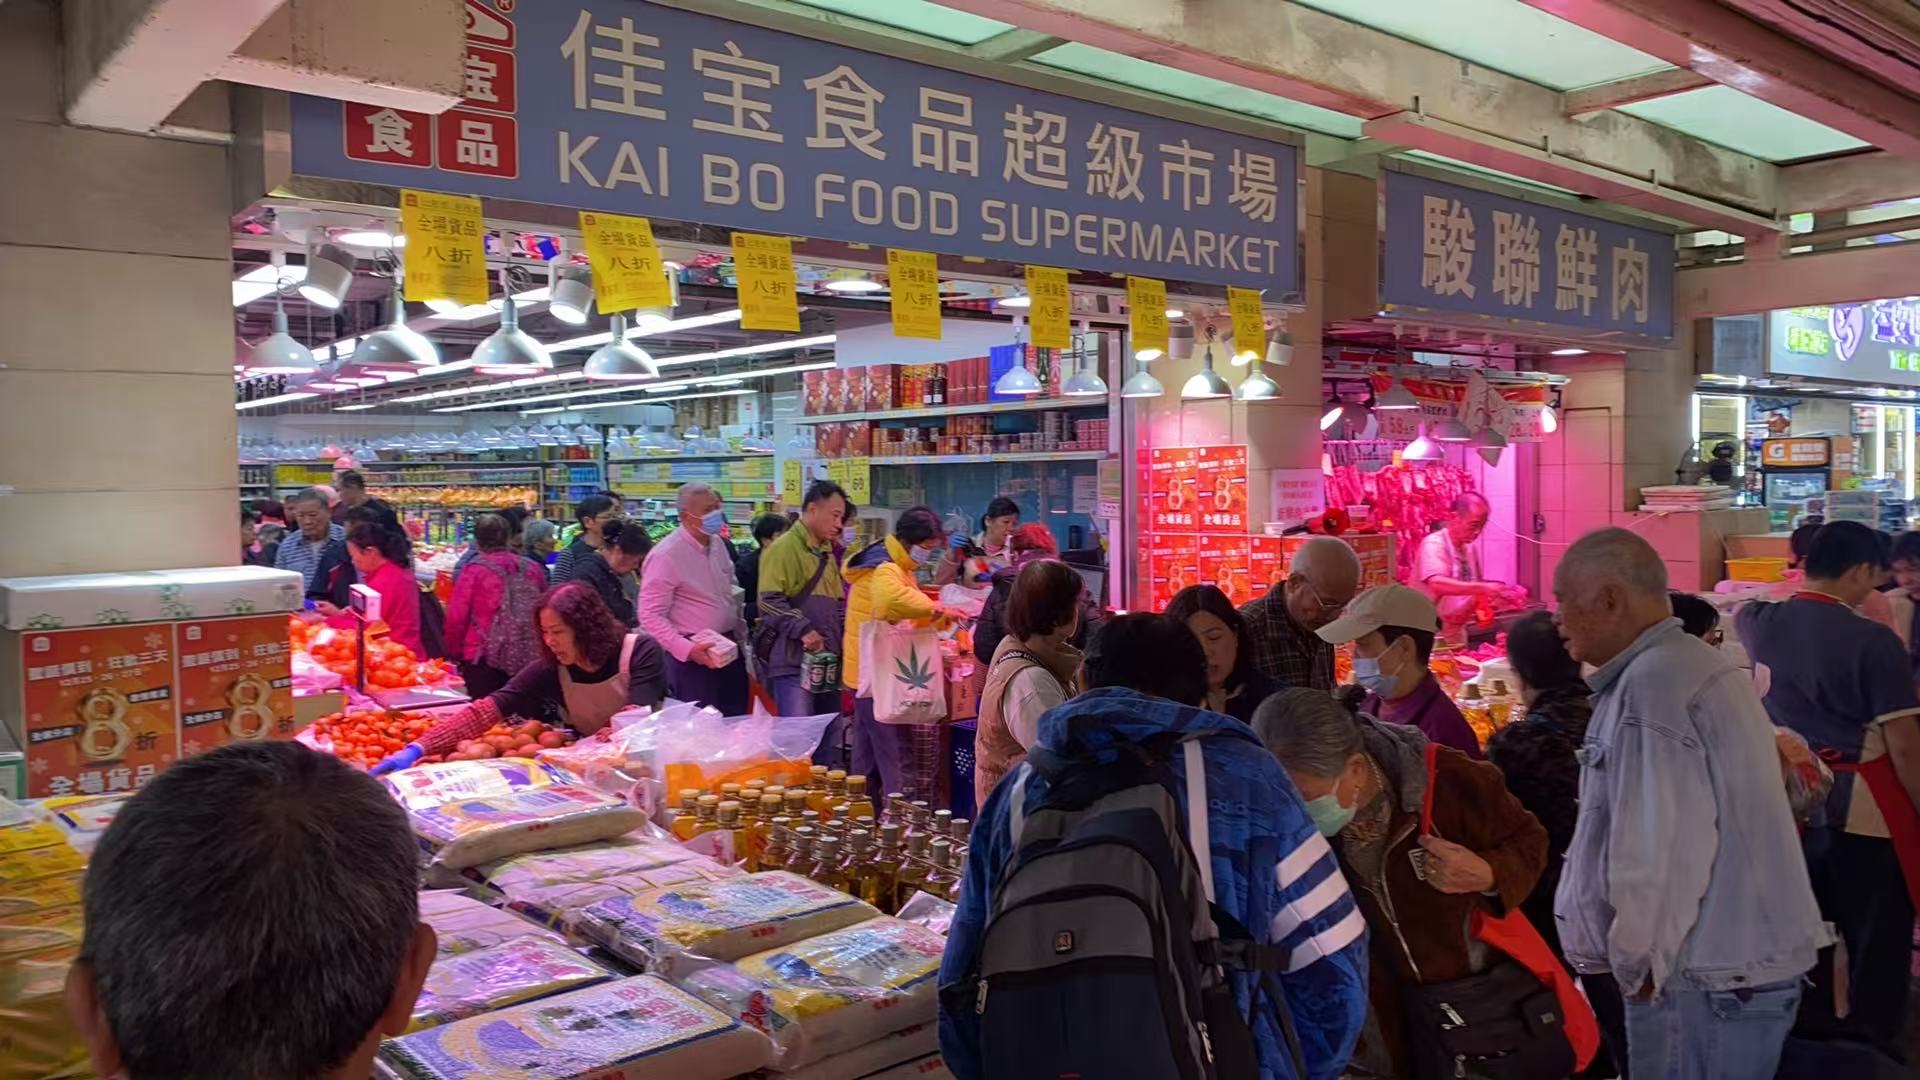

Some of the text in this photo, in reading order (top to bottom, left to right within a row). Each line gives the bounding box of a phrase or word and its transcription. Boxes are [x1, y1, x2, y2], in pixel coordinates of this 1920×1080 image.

[364, 108, 499, 167] 食品
[558, 130, 1281, 275] KAI BO FOOD SUPERMARKET
[422, 245, 473, 265] 八折
[608, 255, 651, 271] 八折
[1421, 194, 1650, 324] 駿聯鮮肉
[751, 279, 788, 296] 八折
[903, 291, 933, 307] 八折
[1038, 305, 1065, 319] 八折
[1768, 443, 1785, 458] G
[229, 673, 273, 740] 8
[80, 687, 131, 762] 8
